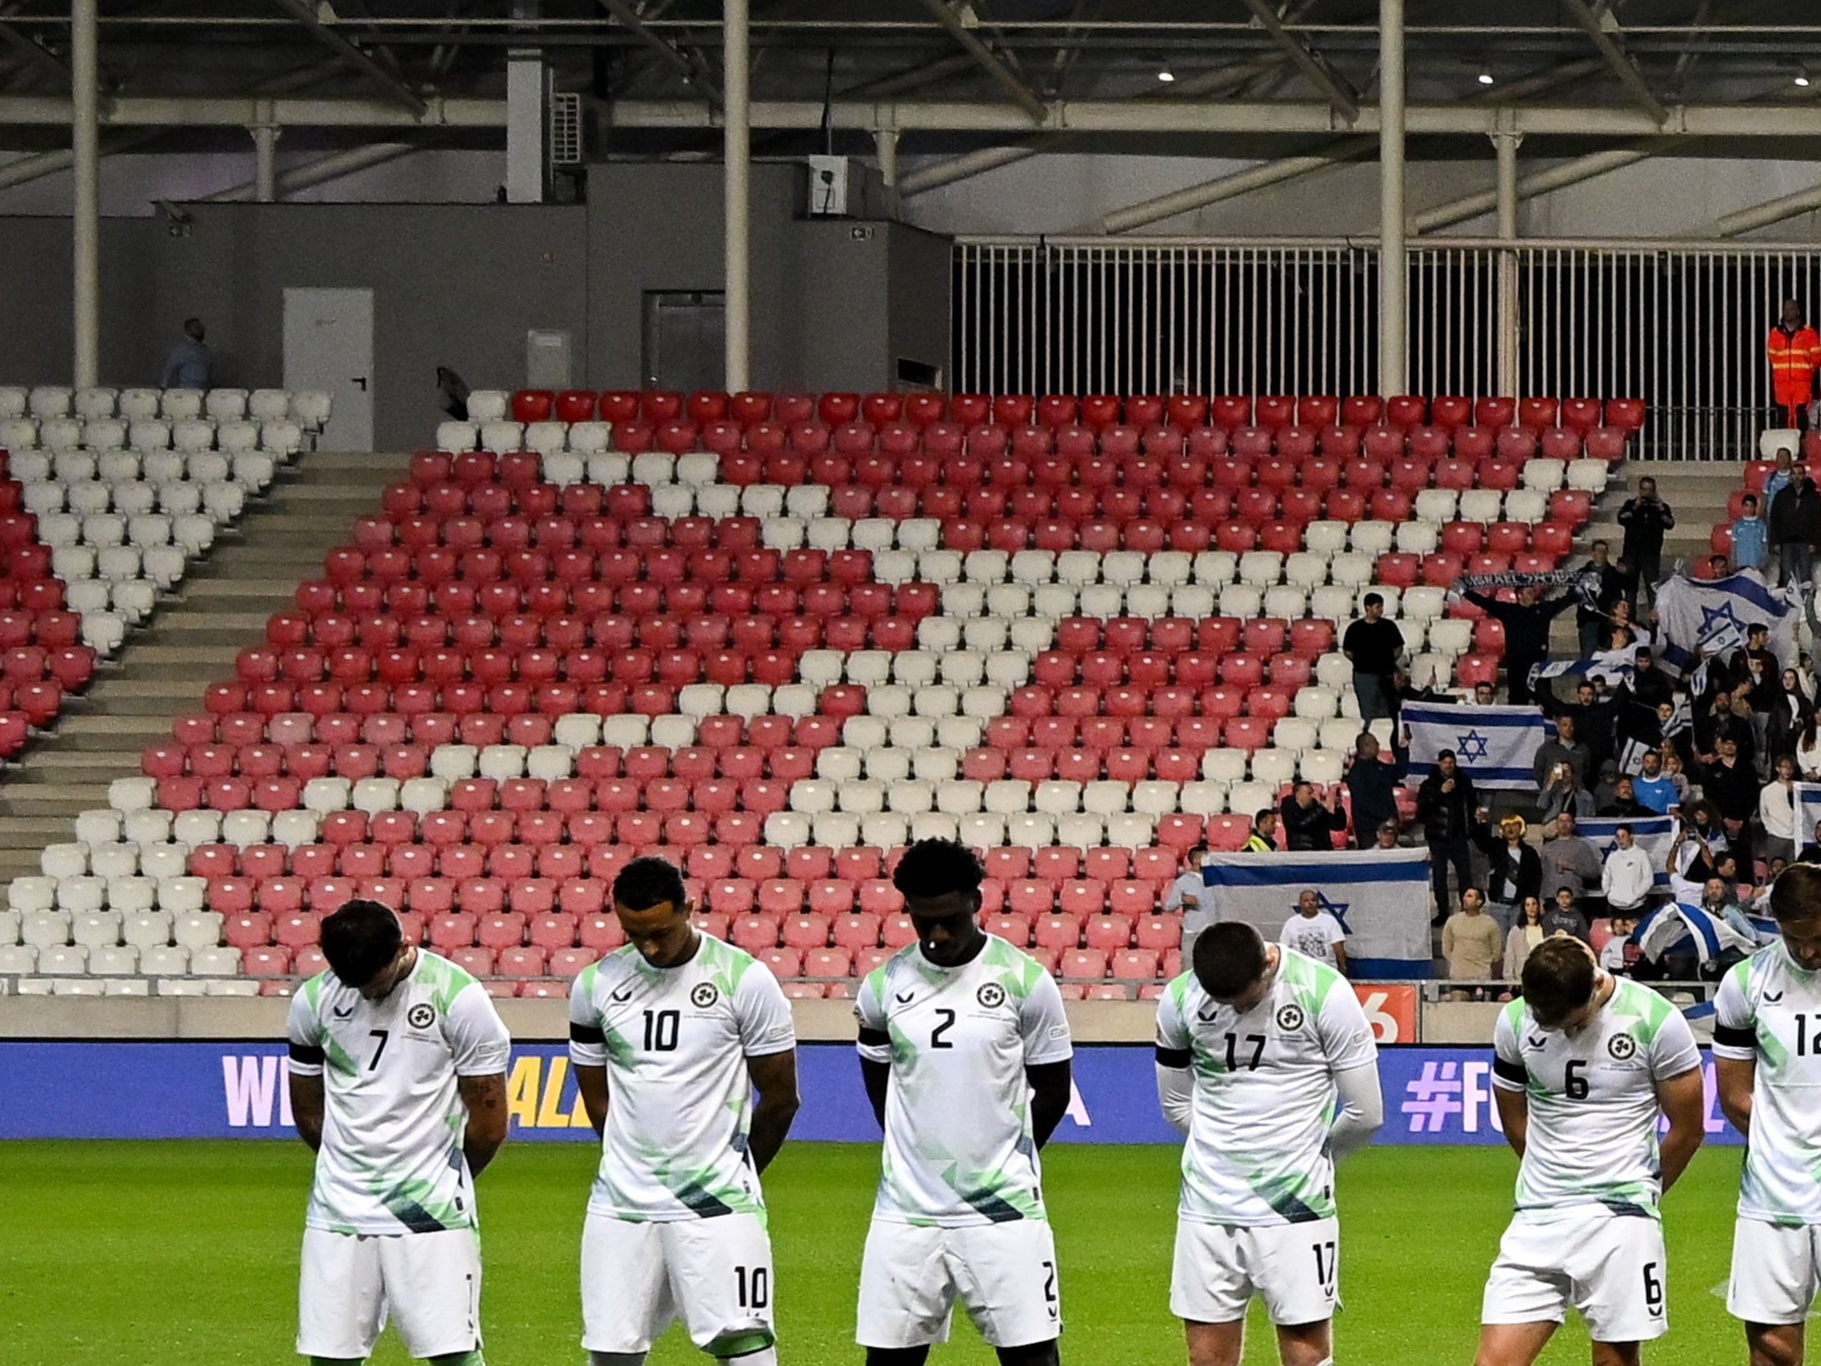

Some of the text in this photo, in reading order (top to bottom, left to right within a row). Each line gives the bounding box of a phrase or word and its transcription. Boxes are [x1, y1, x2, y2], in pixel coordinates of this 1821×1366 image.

[643, 1010, 680, 1051] 10
[931, 1009, 955, 1048] 2
[368, 1030, 389, 1071] 7
[1223, 1032, 1266, 1072] 17
[1565, 1059, 1589, 1100] 6
[1042, 1261, 1056, 1302] 2
[1312, 1241, 1335, 1285] 17
[1643, 1262, 1662, 1305] 6
[734, 1266, 767, 1309] 10
